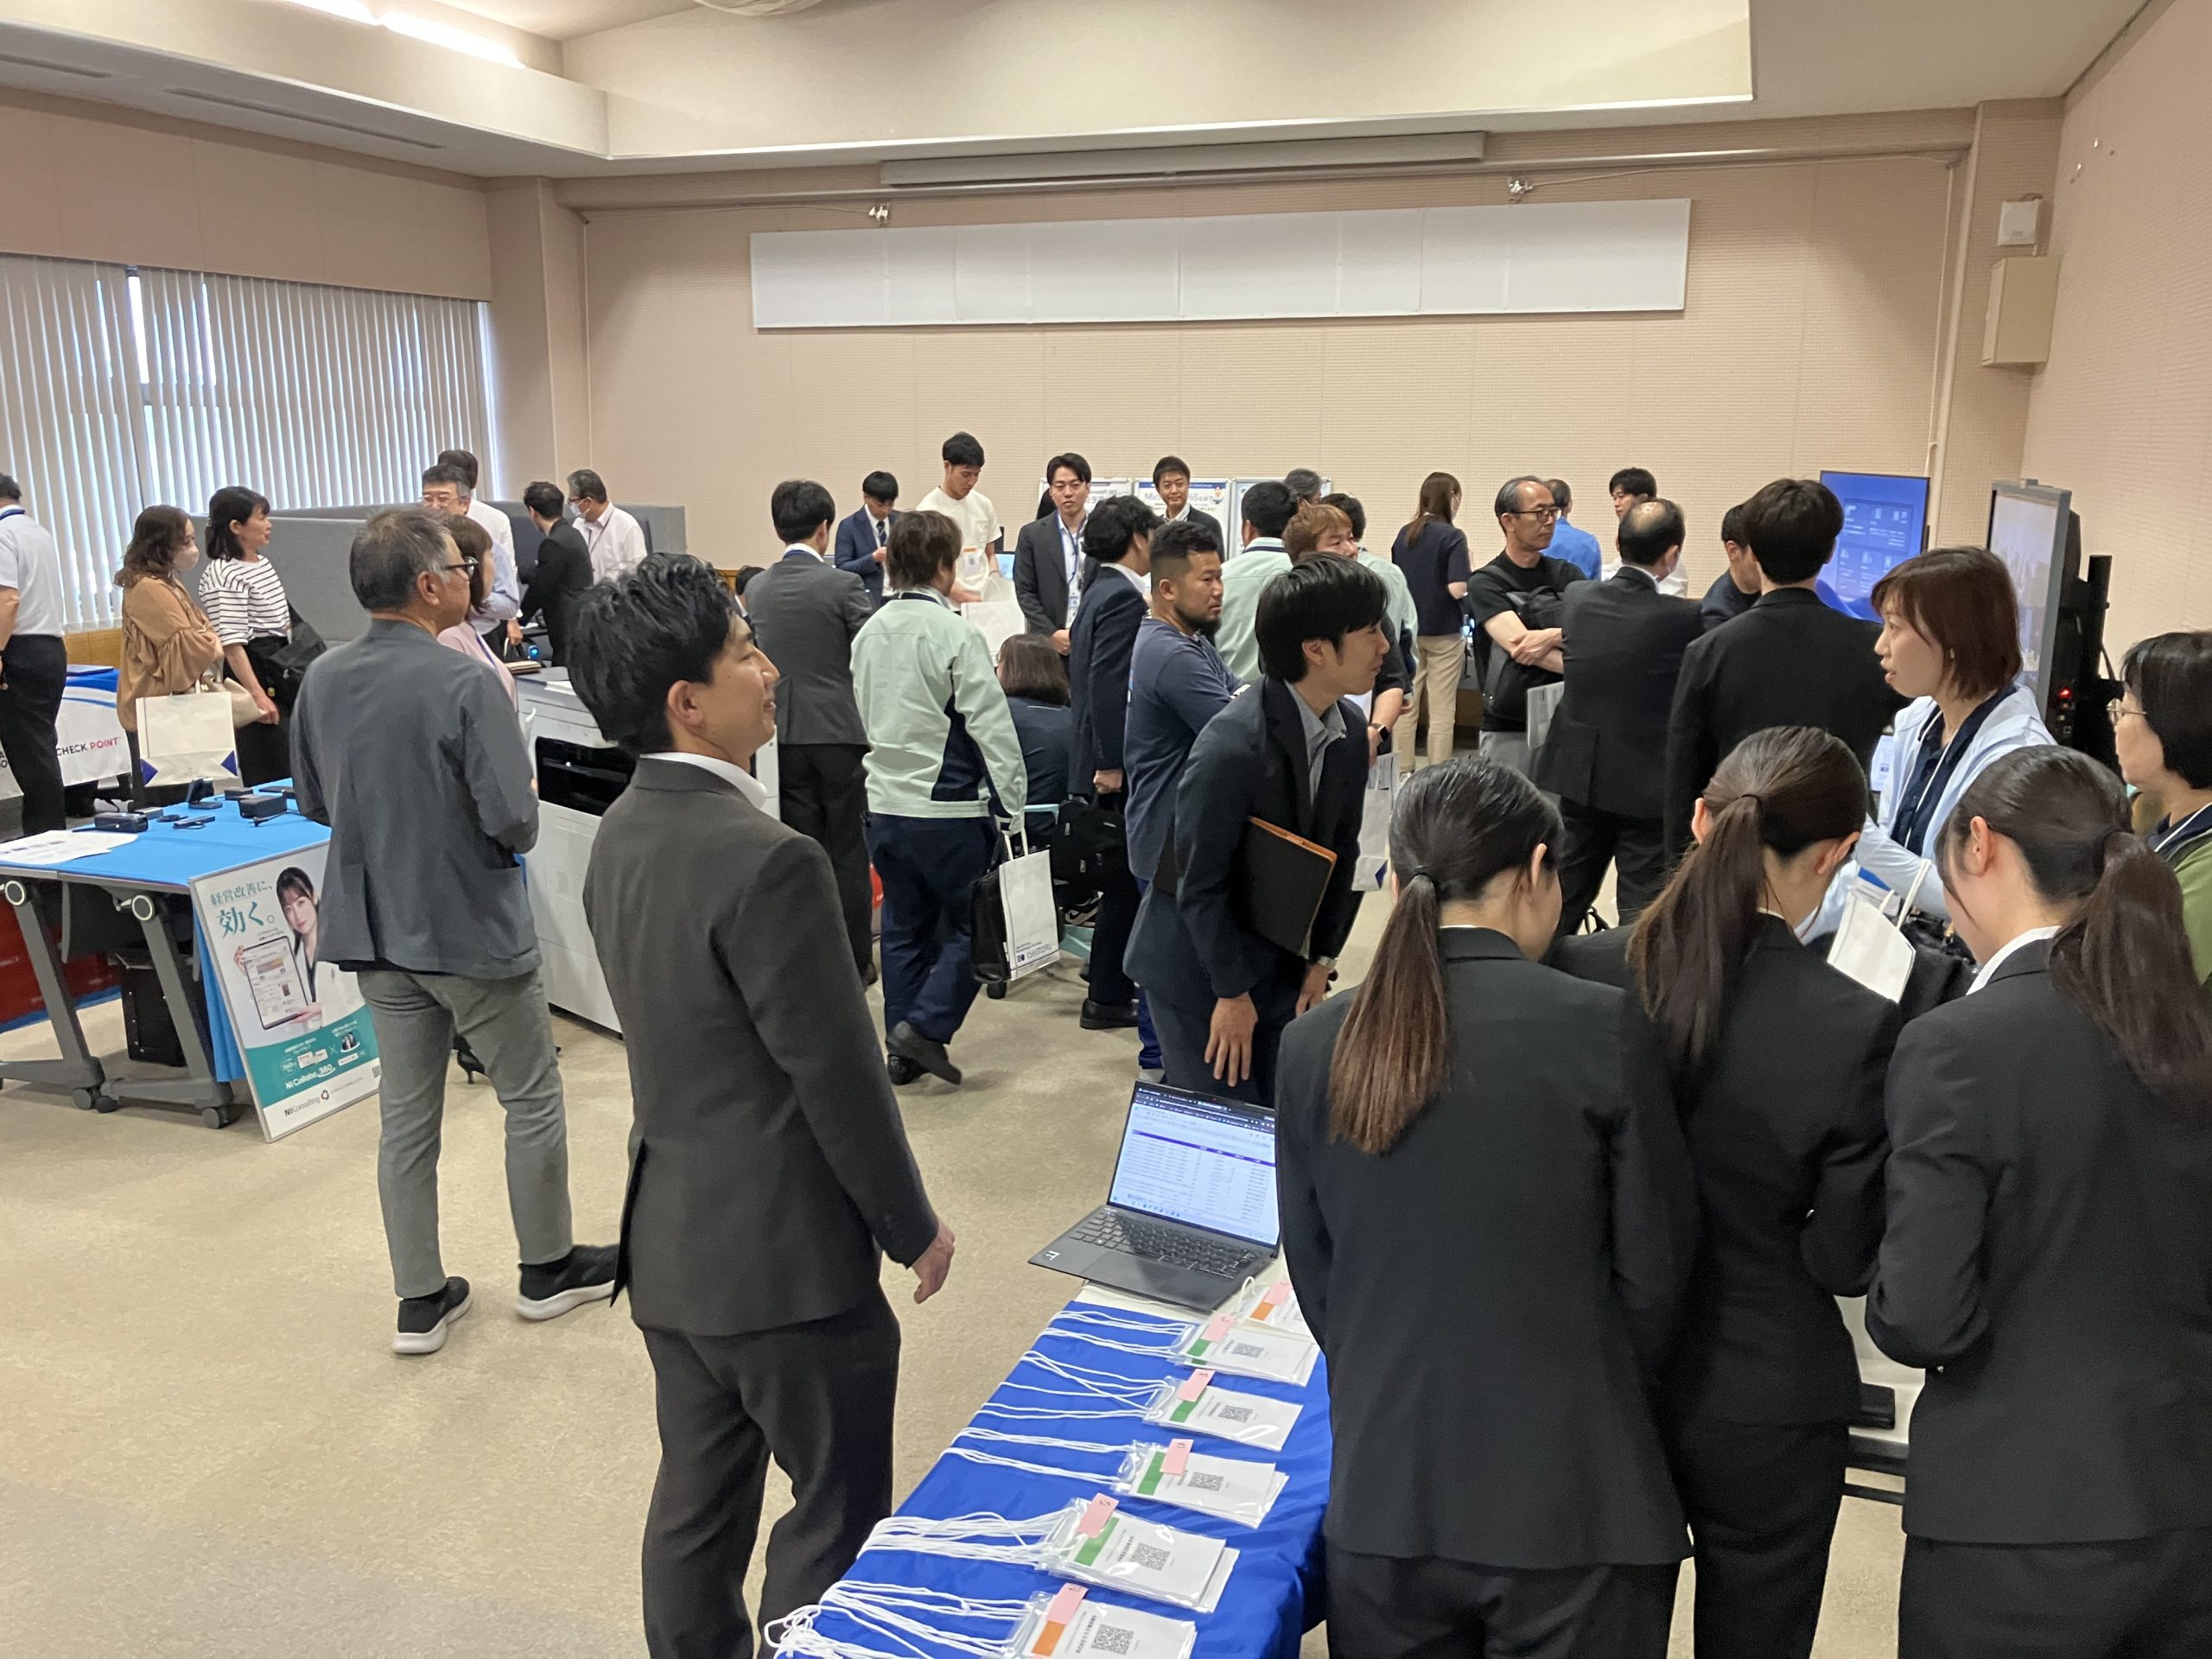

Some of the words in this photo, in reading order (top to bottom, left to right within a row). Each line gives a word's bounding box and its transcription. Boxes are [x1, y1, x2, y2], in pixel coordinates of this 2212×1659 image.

[56, 743, 87, 756] CHECK
[89, 737, 118, 750] POINT
[210, 880, 273, 906] 経営改善に、
[217, 901, 276, 939] 効く。
